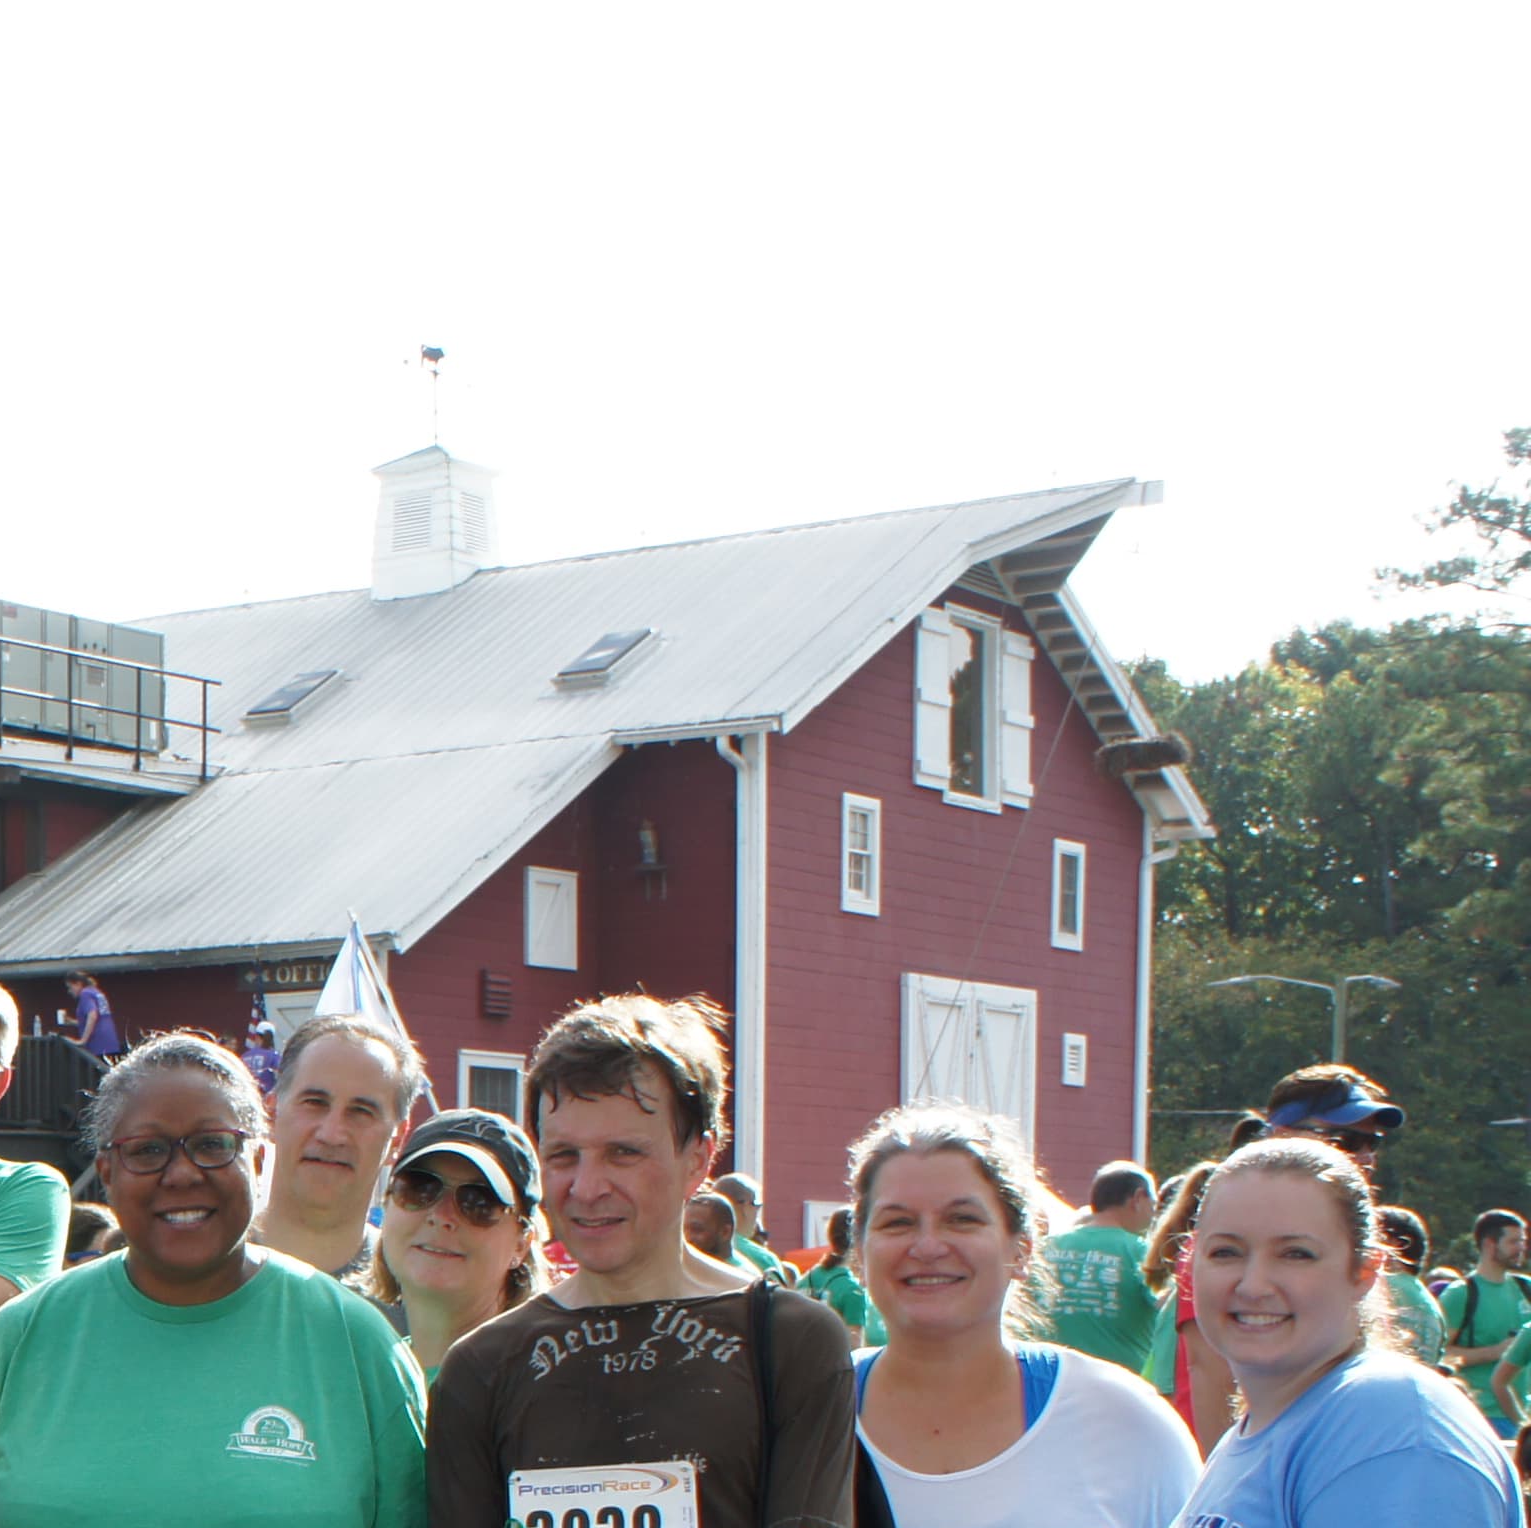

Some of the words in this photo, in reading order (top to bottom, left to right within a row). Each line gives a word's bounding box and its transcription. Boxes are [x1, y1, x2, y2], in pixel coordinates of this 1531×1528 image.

[530, 1319, 619, 1380] New
[641, 1302, 742, 1364] York
[600, 1350, 657, 1374] 1978
[240, 1435, 267, 1445] WALK
[276, 1438, 302, 1451] HOPE
[518, 1480, 650, 1497] PrecisionRace
